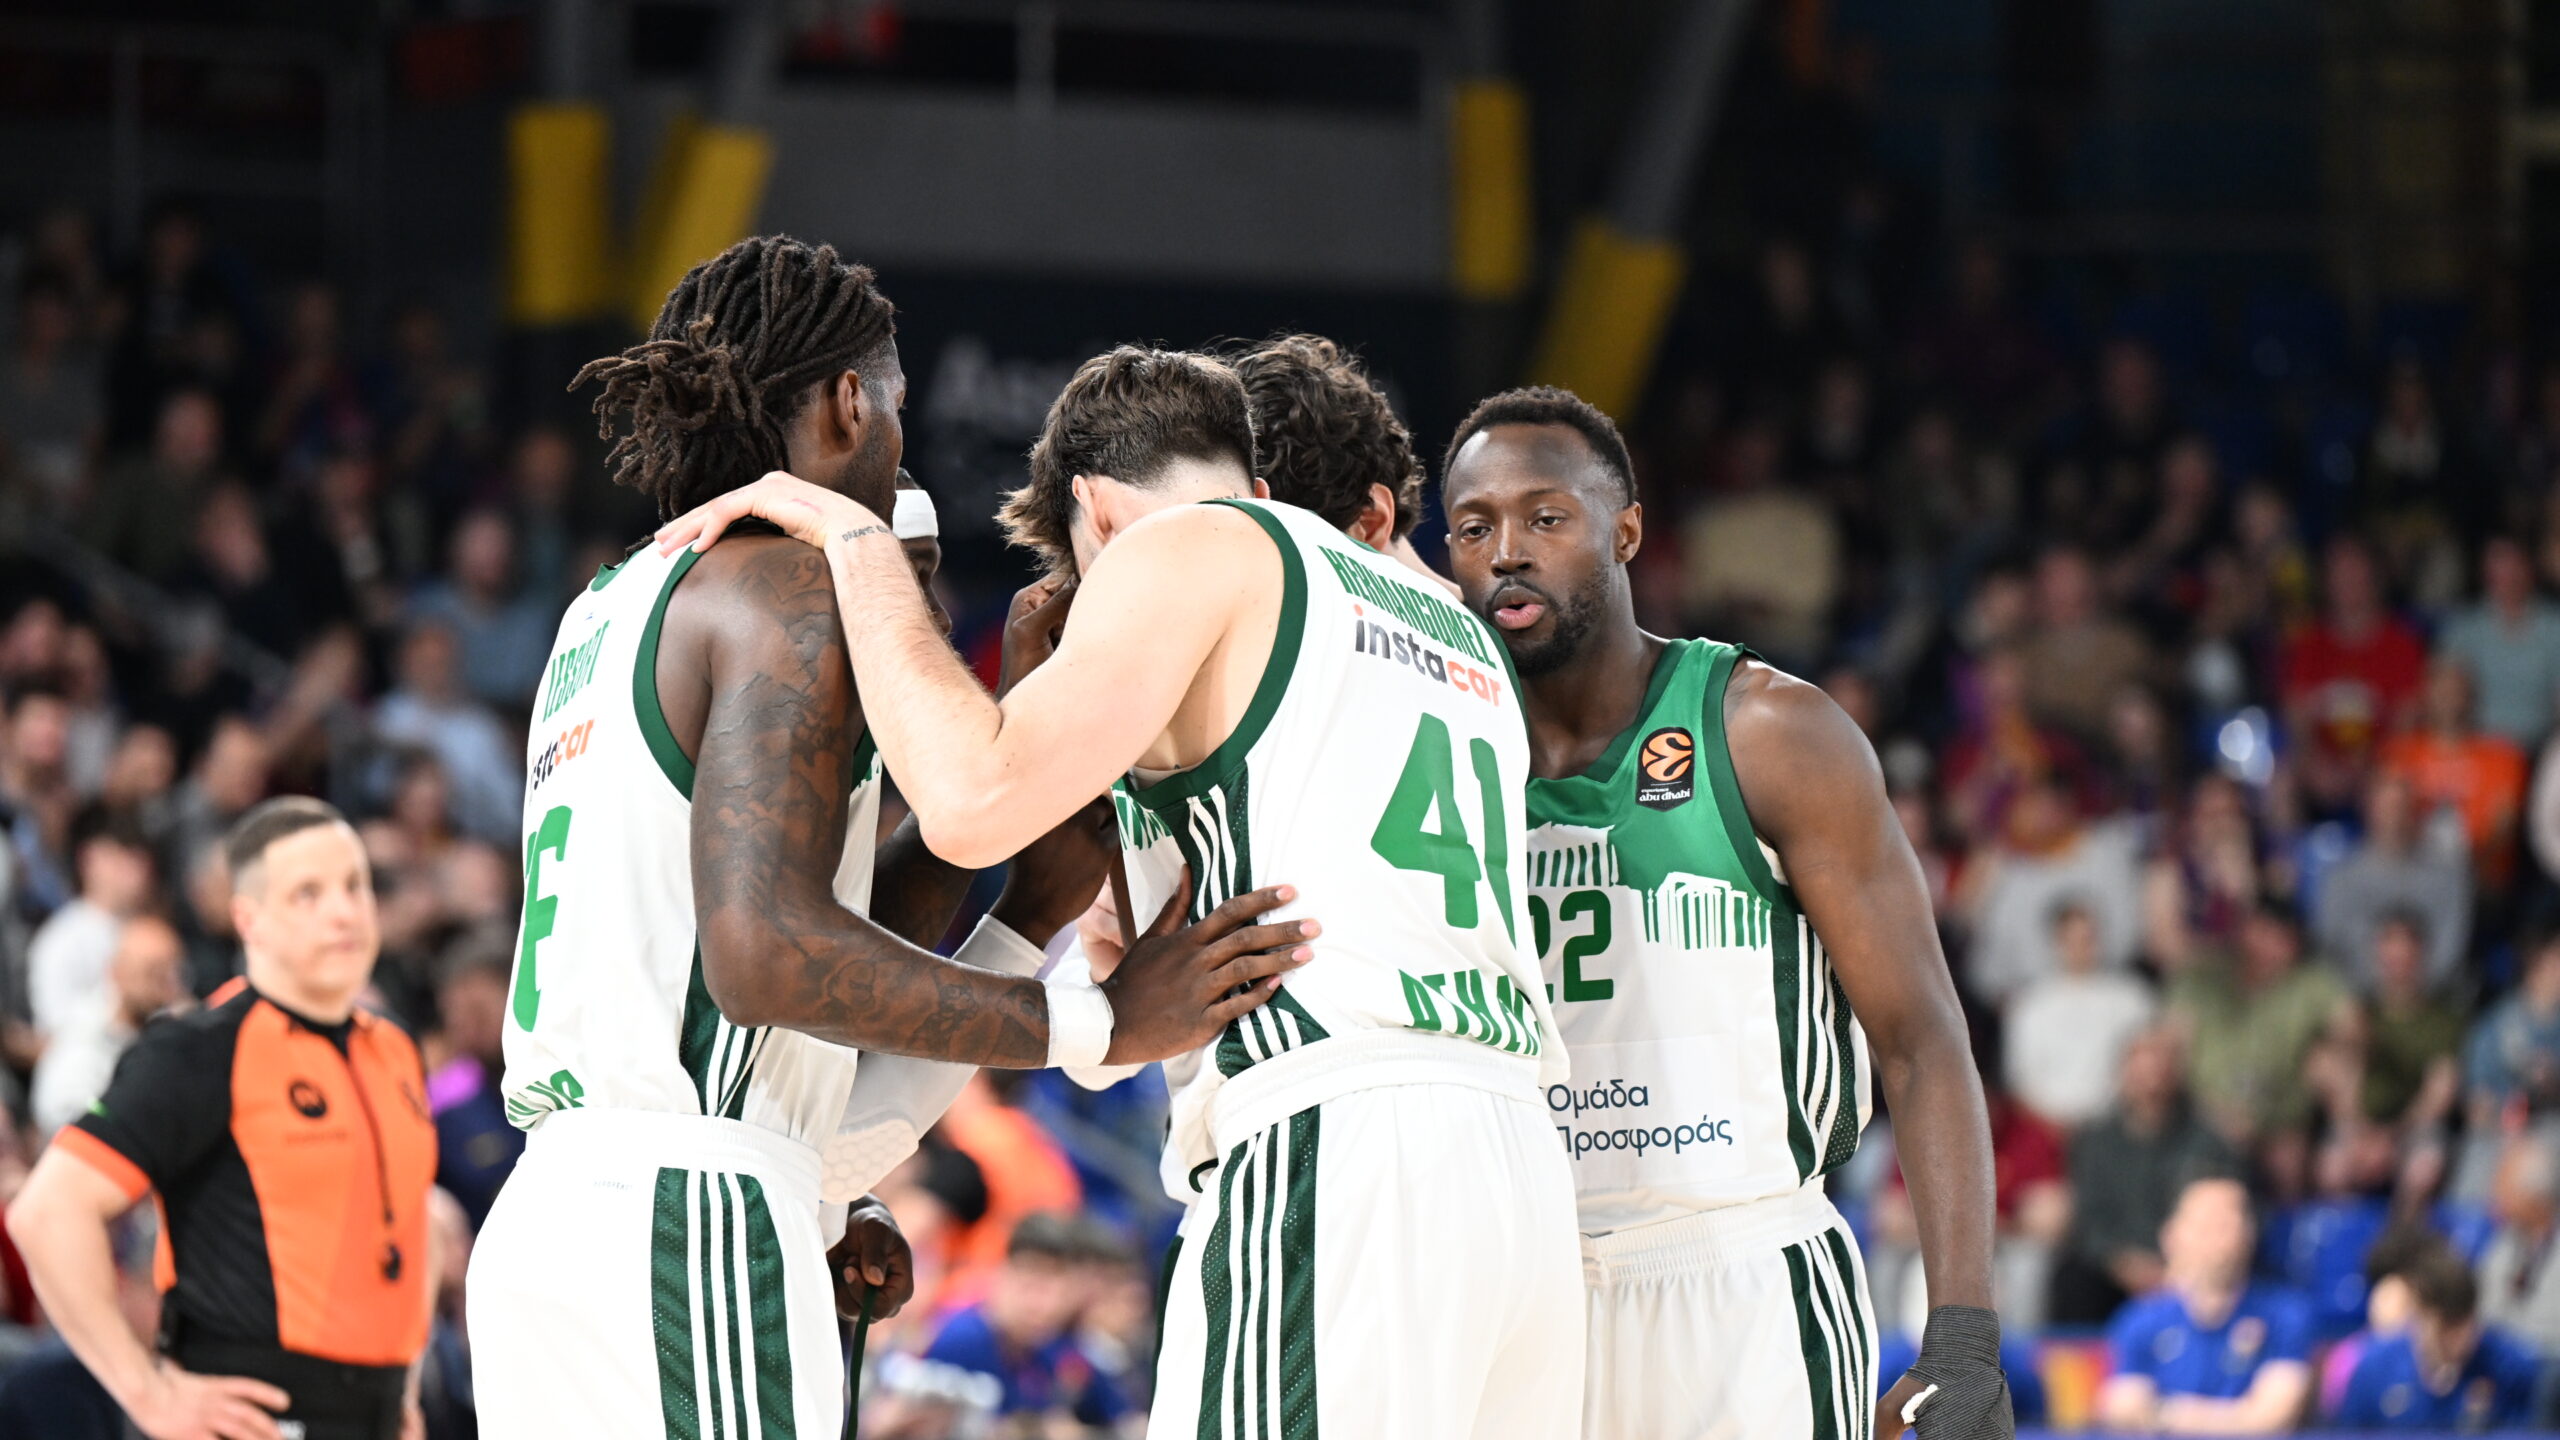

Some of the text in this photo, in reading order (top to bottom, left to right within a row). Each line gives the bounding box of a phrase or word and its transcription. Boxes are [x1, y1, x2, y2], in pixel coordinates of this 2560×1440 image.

[1317, 545, 1497, 670] HERNANGOMEZ
[1354, 604, 1501, 707] instacar
[1370, 712, 1517, 950] 41
[1639, 788, 1690, 801] abu dhabi
[1547, 1079, 1649, 1119] Ομάδα
